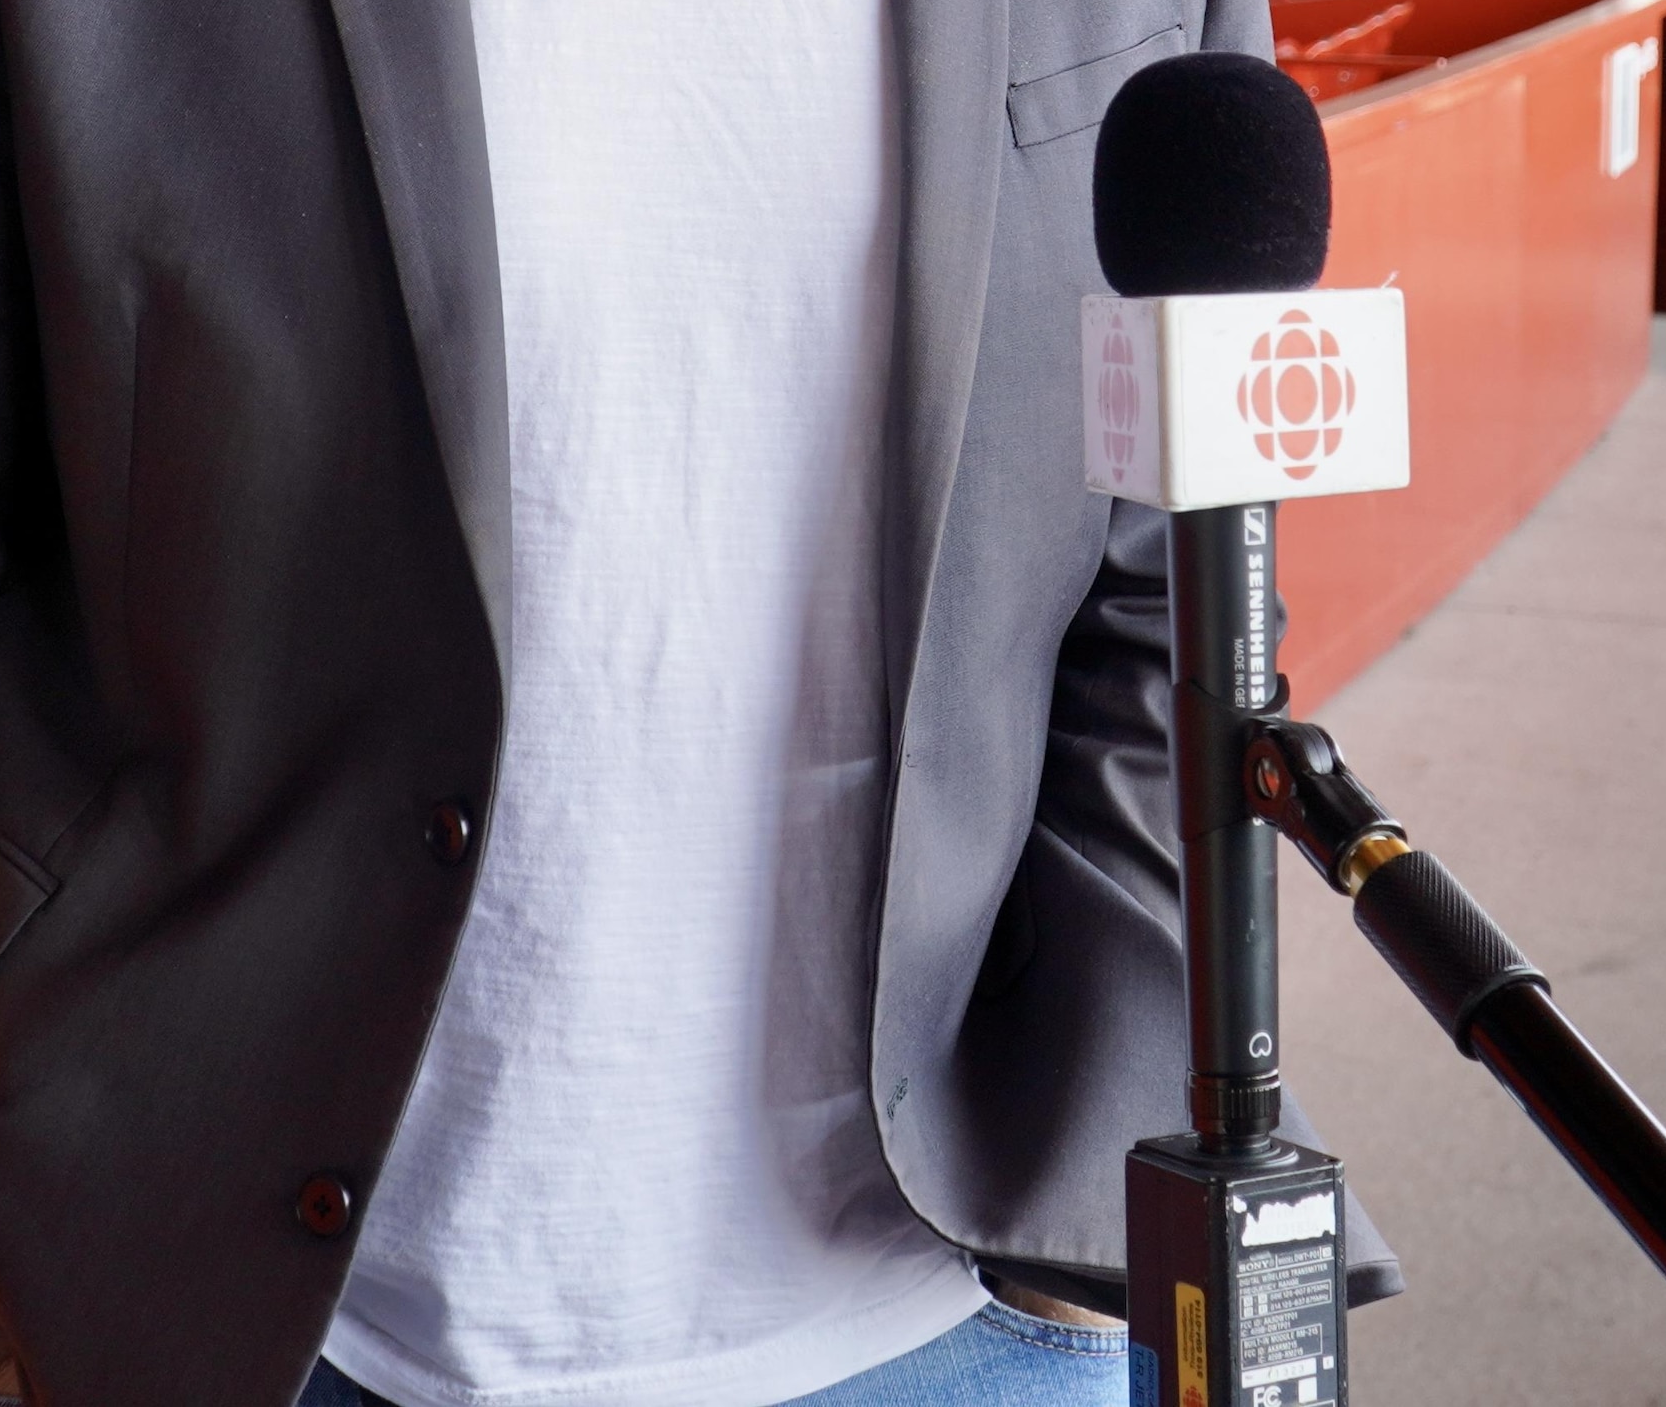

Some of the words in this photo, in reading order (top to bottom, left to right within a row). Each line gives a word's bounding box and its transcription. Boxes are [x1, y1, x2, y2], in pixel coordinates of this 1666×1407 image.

[1234, 638, 1245, 671] MADE
[1235, 673, 1245, 686] IN
[1239, 1260, 1269, 1272] SONY
[1261, 1271, 1290, 1282] WIRELESS
[1290, 1264, 1327, 1277] TRANSMITTER
[1270, 1332, 1294, 1343] MODULE
[1243, 1349, 1255, 1359] FCC
